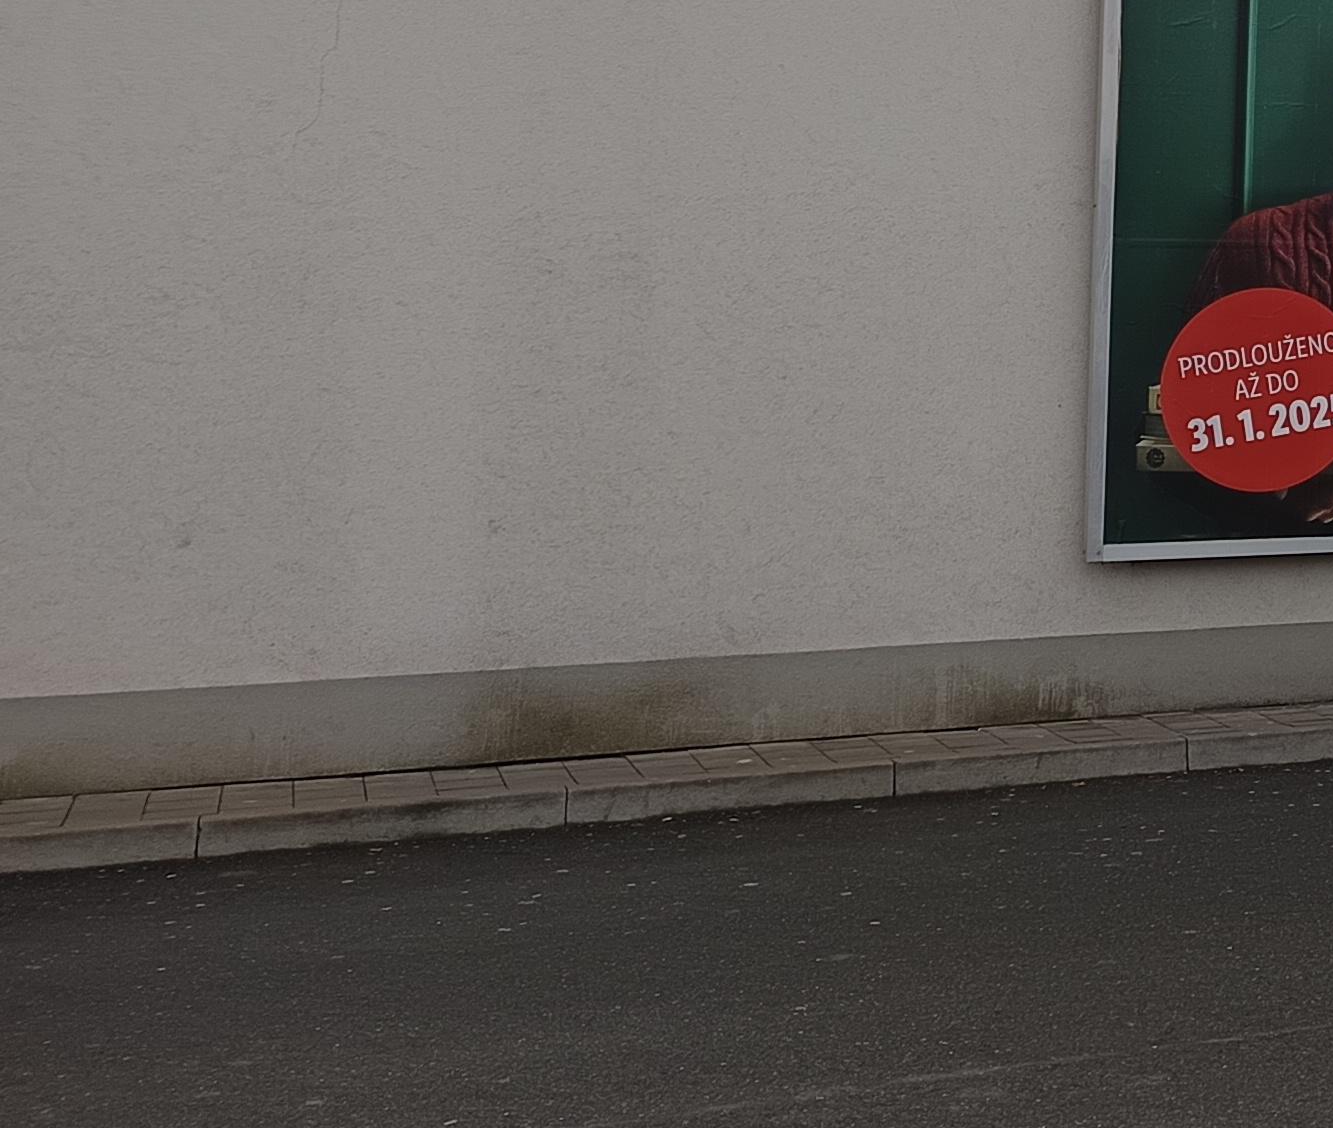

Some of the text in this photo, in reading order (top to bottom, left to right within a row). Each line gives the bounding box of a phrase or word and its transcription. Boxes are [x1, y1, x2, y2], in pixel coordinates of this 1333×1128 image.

[1234, 369, 1299, 401] AŽ DO
[1187, 415, 1234, 452] 31.
[1237, 409, 1265, 442] 1.
